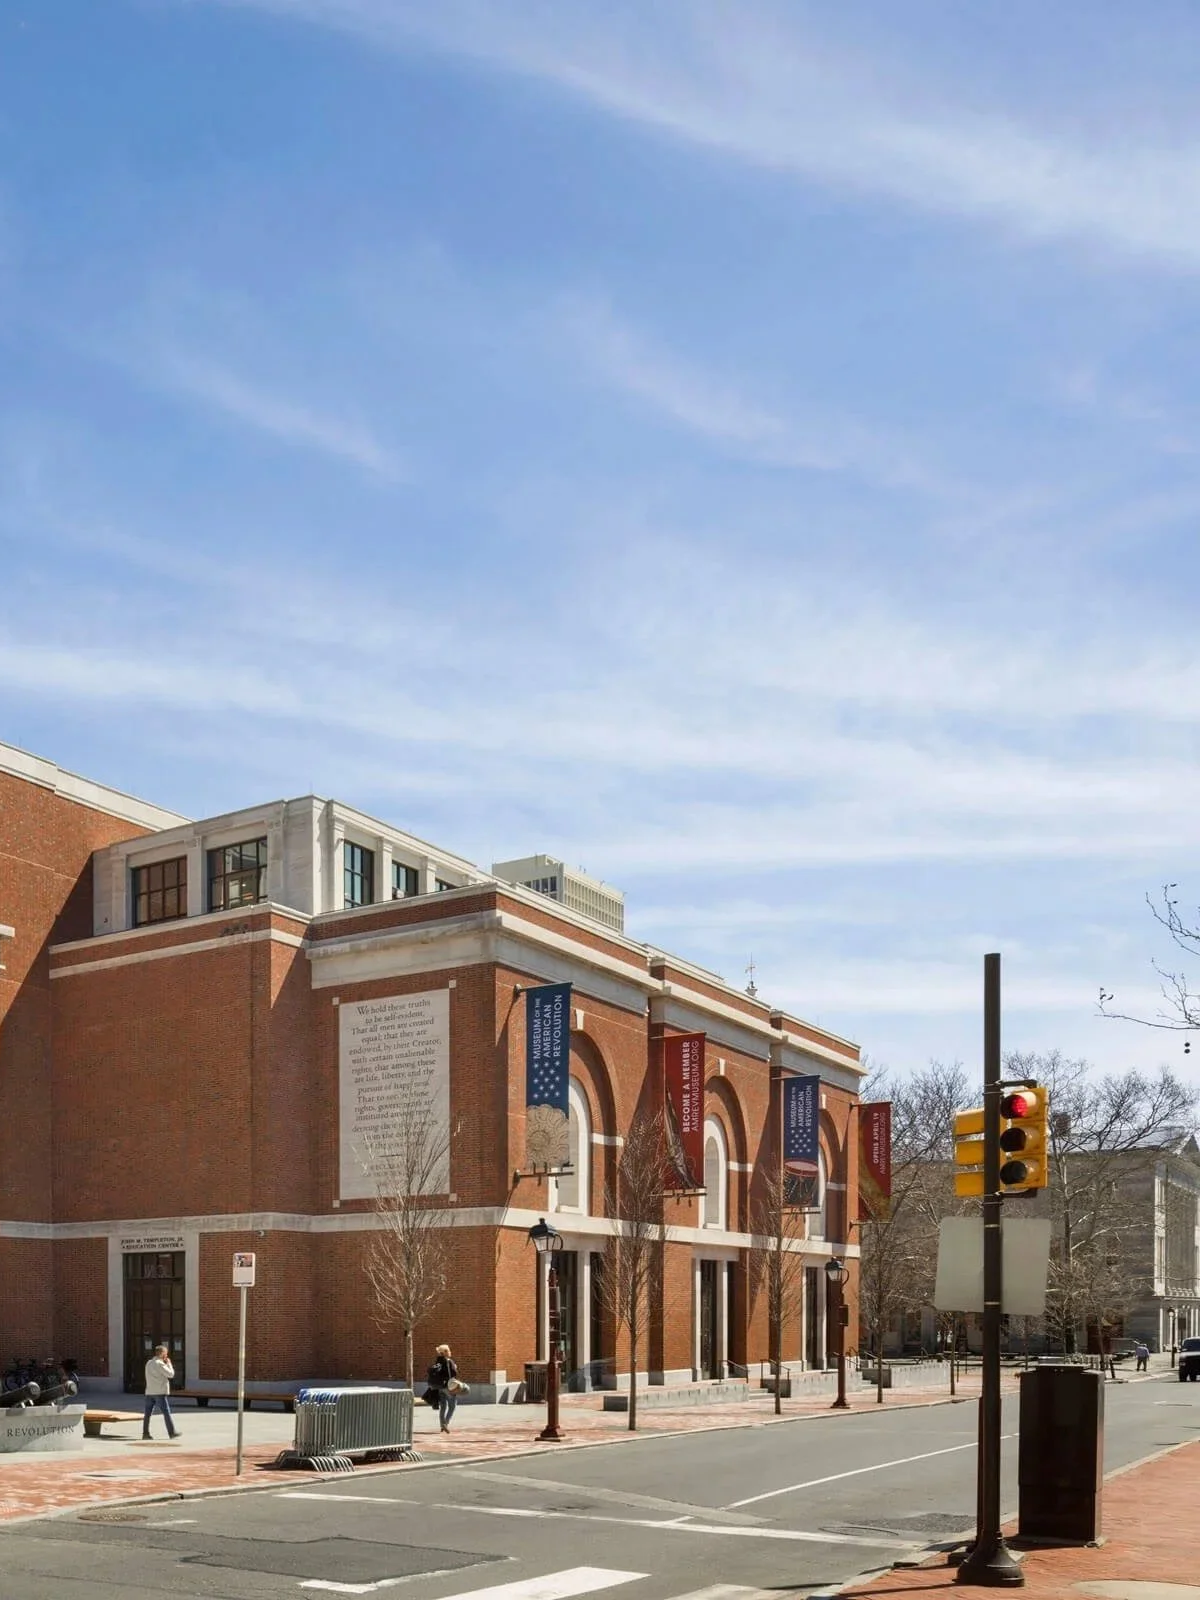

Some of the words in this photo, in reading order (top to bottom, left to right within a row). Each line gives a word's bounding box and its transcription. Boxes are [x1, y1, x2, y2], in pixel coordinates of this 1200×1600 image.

[533, 1019, 541, 1059] MUSEUM
[543, 1004, 552, 1058] AMERICAN
[553, 994, 562, 1057] REVOLUTION
[682, 1041, 691, 1080] MEMBER
[691, 1040, 700, 1132] AMREVMUSEUM.ORG
[682, 1093, 691, 1133] BECOME
[7, 1425, 75, 1437] REVOLUTION
